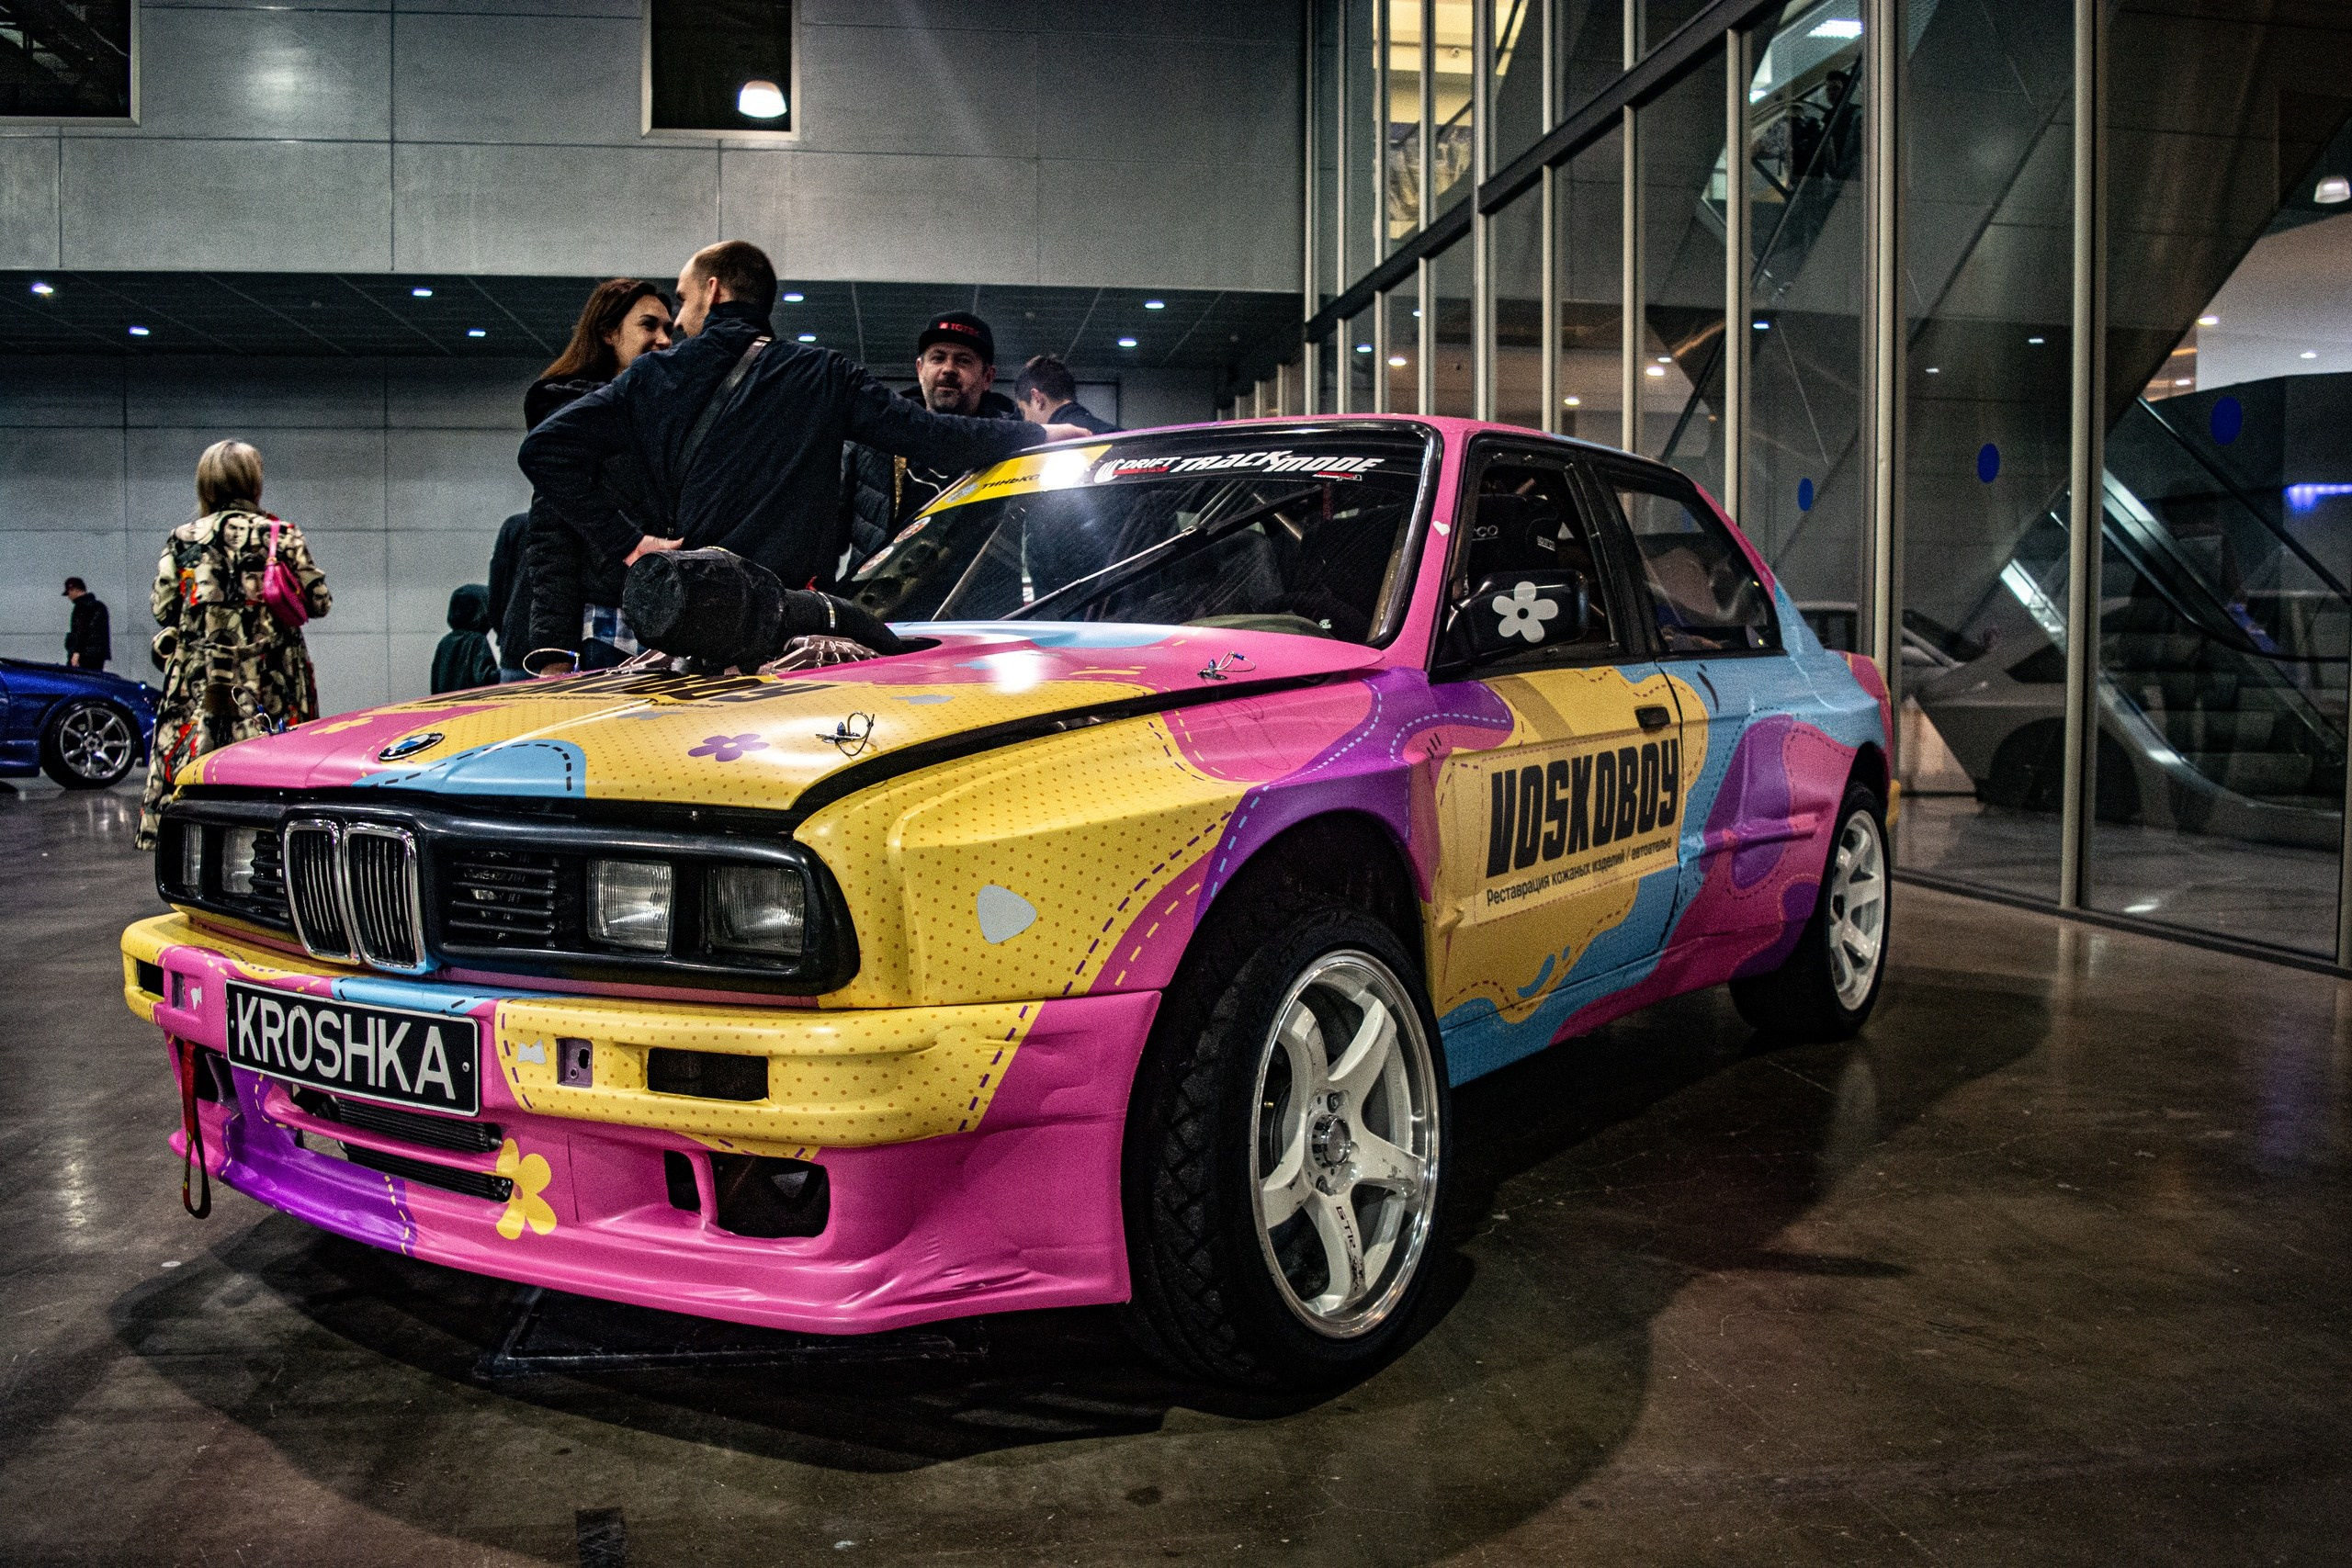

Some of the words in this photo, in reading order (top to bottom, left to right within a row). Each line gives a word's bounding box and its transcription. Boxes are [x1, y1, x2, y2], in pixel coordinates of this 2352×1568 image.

[1118, 457, 1182, 470] DRIFT
[1486, 738, 1679, 879] VOSKOBOY
[1487, 875, 1550, 907] Реставрация
[1552, 861, 1591, 886] кожаных
[1591, 849, 1625, 874] изделий
[1632, 837, 1672, 862] автоателье
[236, 992, 457, 1100] KROSHKA
